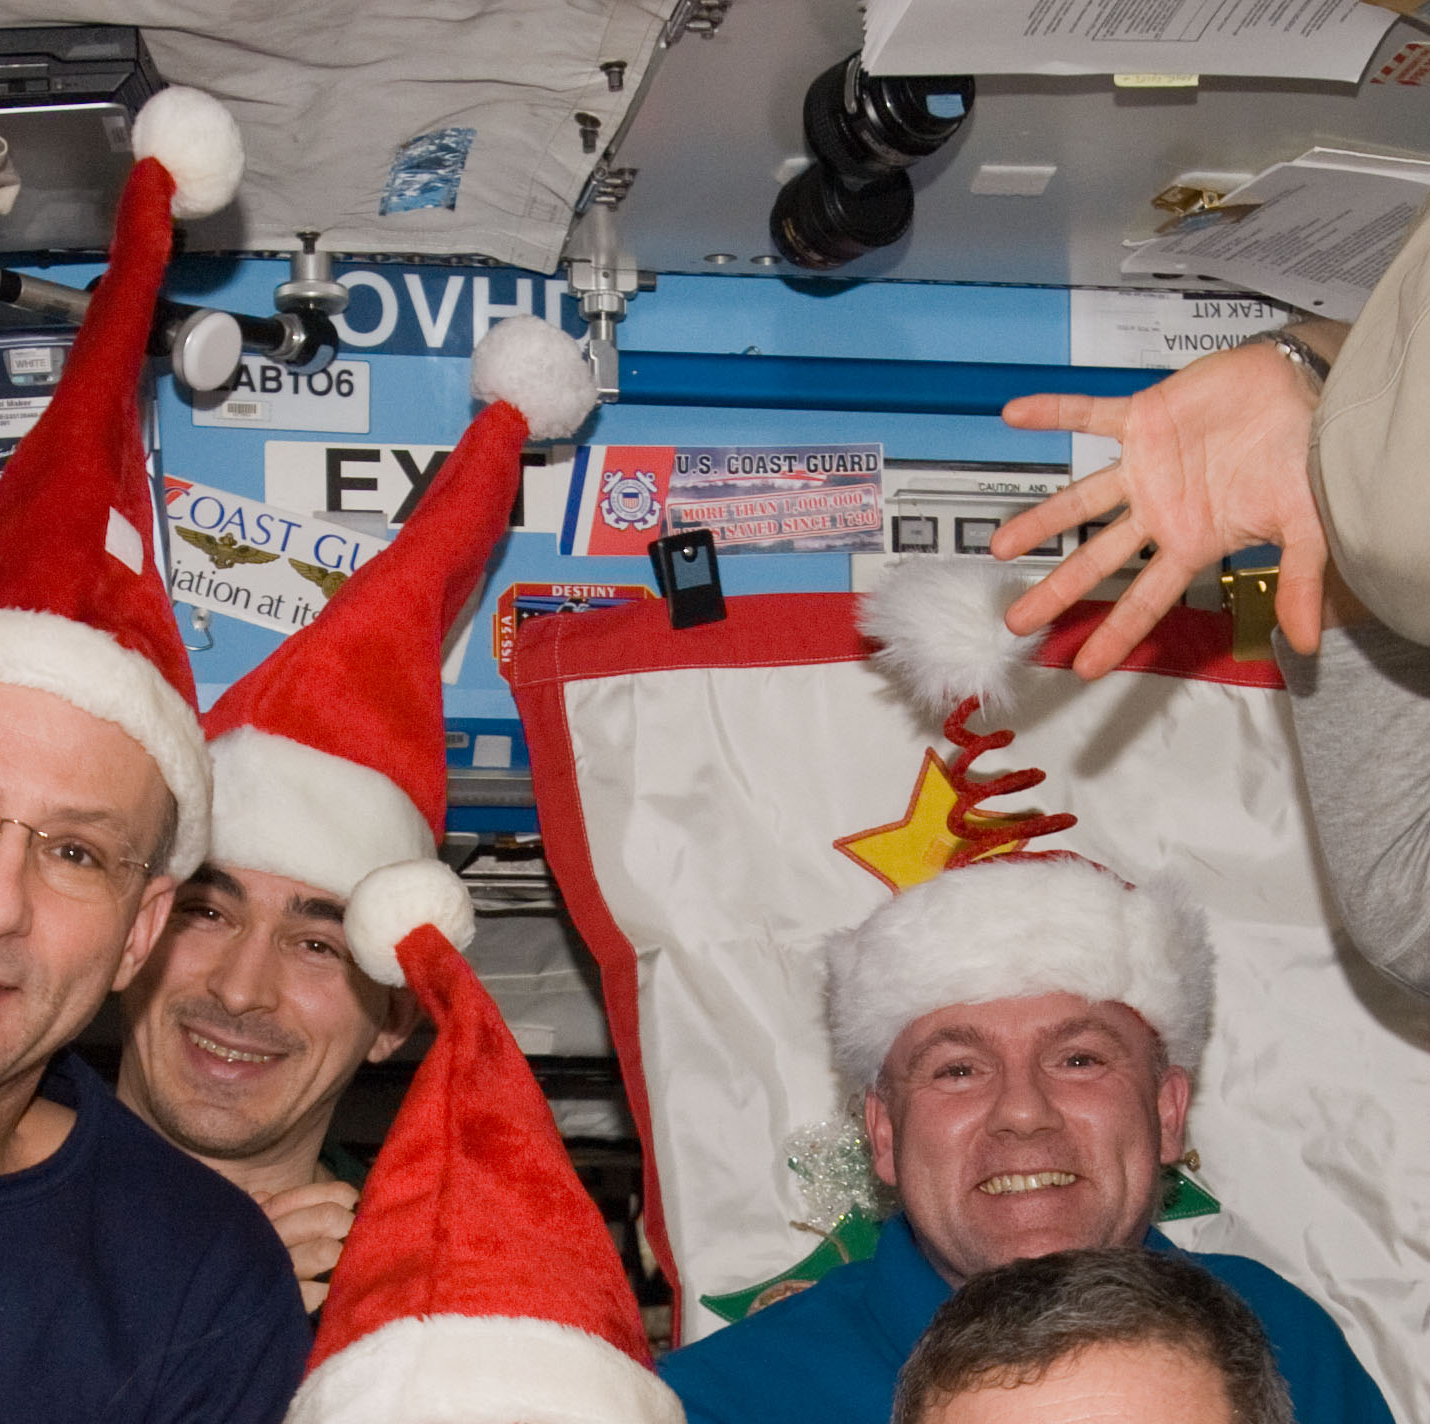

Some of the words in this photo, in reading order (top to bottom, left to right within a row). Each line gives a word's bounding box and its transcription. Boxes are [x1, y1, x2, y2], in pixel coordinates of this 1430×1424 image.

[1191, 302, 1220, 318] KIT
[1227, 302, 1274, 318] LEAK
[1163, 333, 1255, 351] MMONIA
[14, 359, 47, 368] WHITE
[677, 455, 718, 474] U.S.
[727, 454, 797, 473] COAST
[806, 453, 878, 473] GUARD
[326, 448, 547, 527] EXT
[979, 482, 1020, 492] CAUTION
[1029, 484, 1048, 493] AND
[682, 505, 729, 522] MORE
[734, 500, 778, 518] THAN
[783, 492, 864, 515] 1,000,000
[166, 486, 302, 552] COAST
[725, 519, 779, 537] SAVED
[782, 515, 832, 532] SINCE
[837, 511, 876, 529] 1790
[171, 559, 252, 611] iation
[256, 592, 285, 620] at
[552, 585, 616, 598] DESTINY
